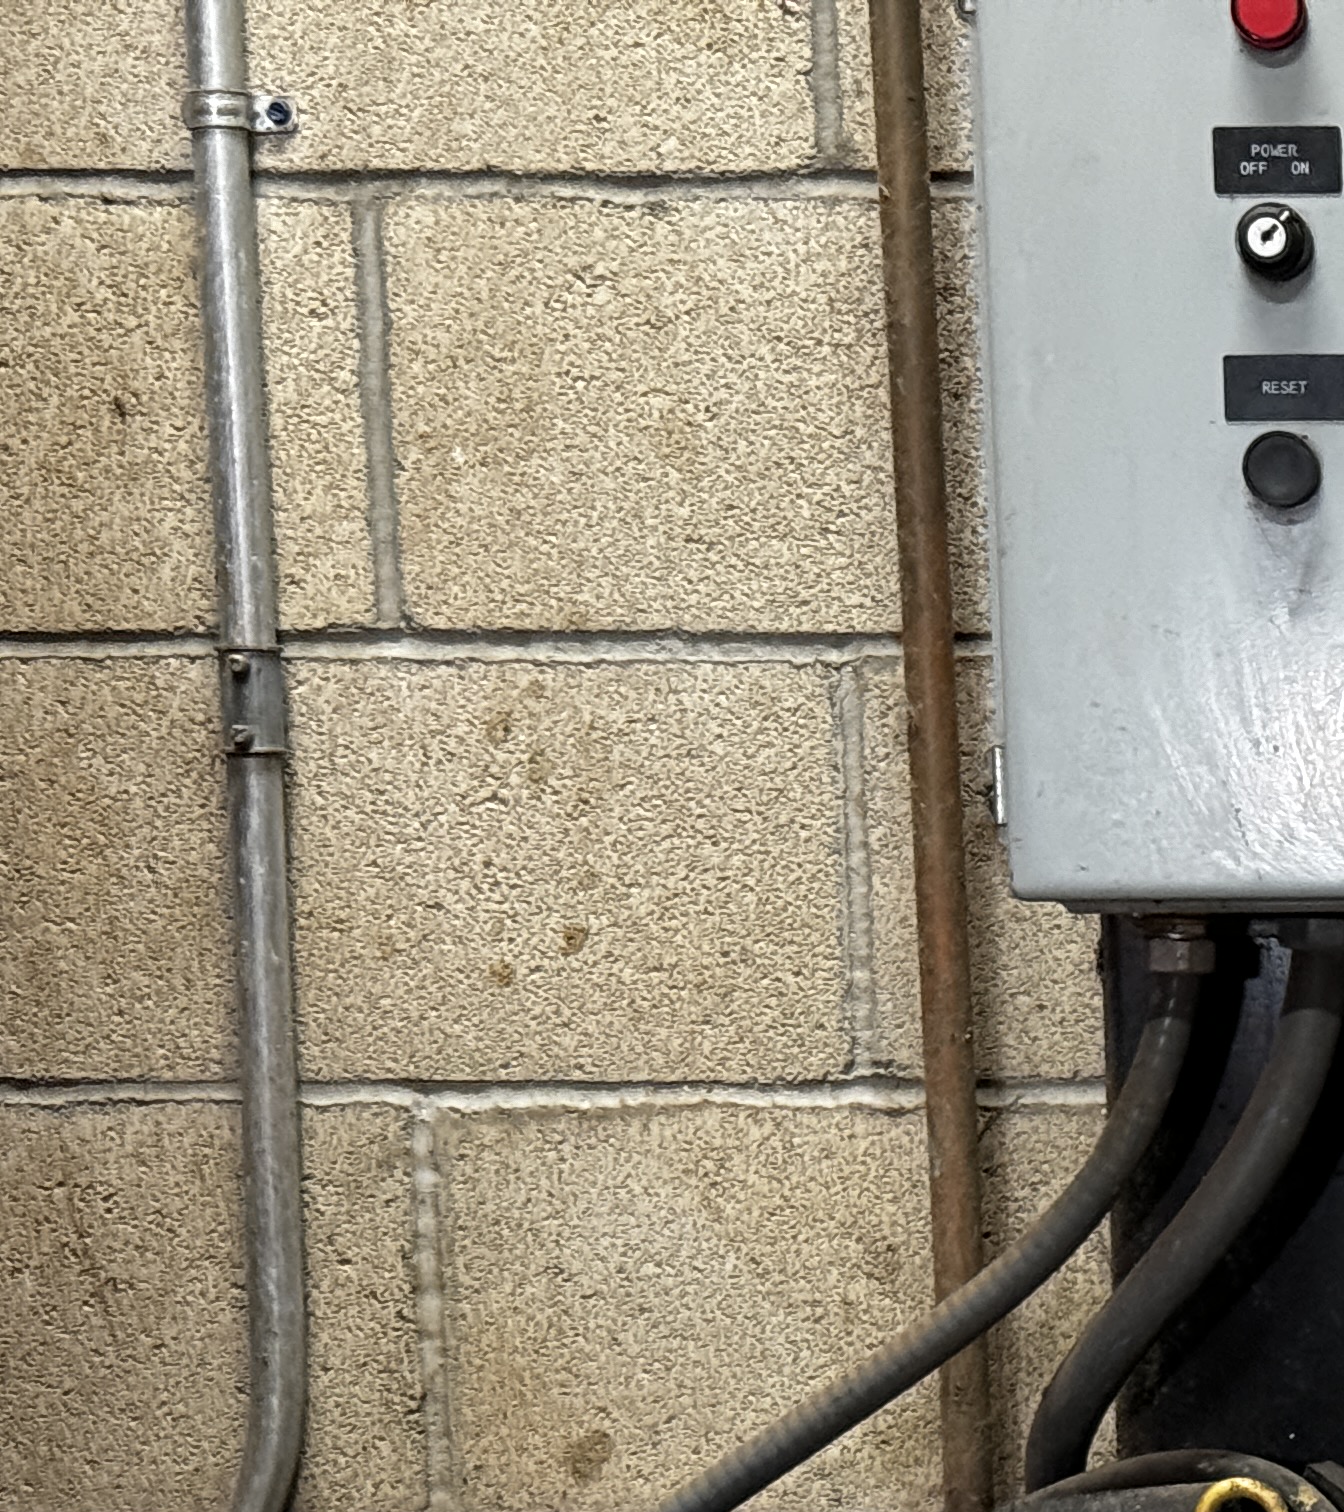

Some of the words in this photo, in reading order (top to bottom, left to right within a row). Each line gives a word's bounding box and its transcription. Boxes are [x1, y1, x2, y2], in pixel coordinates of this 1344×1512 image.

[1251, 144, 1299, 158] POWER
[1240, 161, 1268, 175] OFF
[1291, 161, 1310, 175] ON
[1262, 381, 1307, 394] RESET
